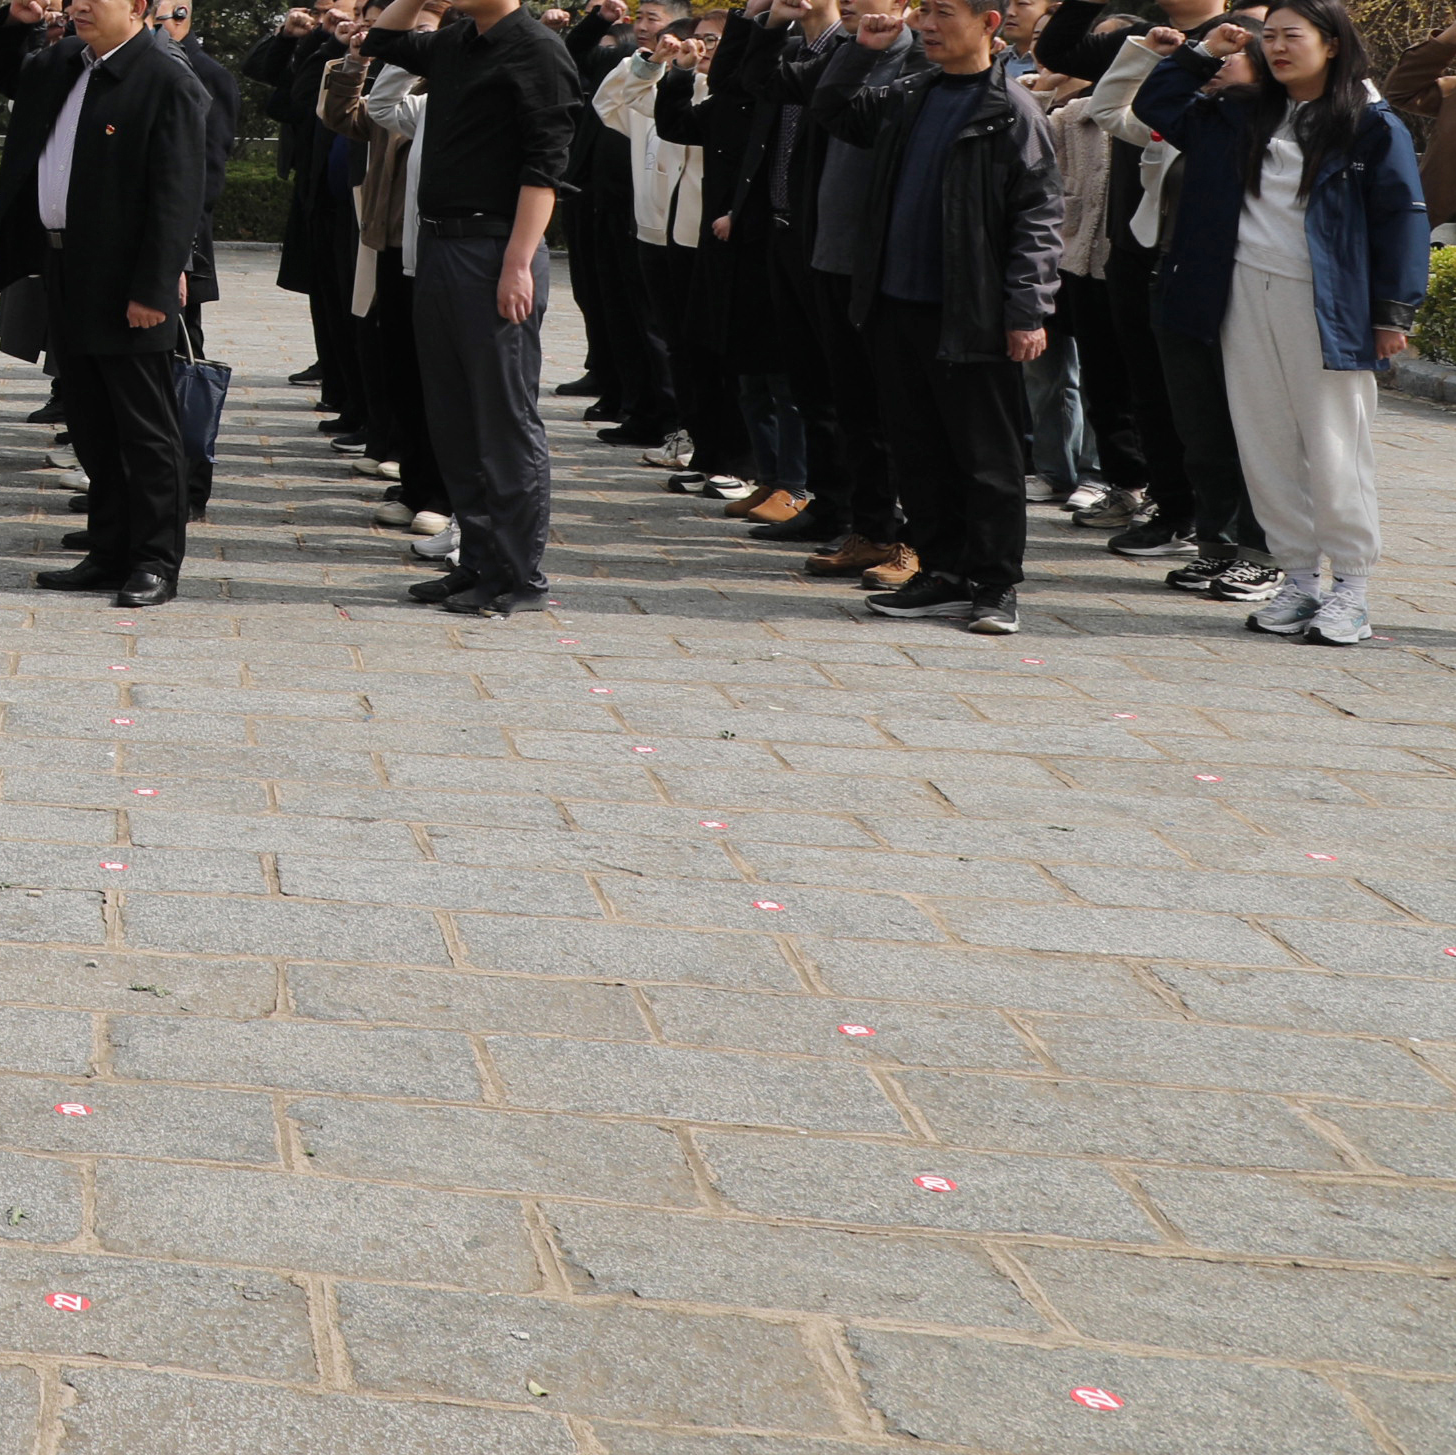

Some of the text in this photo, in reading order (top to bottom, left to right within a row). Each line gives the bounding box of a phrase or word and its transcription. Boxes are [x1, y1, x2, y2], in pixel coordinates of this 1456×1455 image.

[844, 1026, 869, 1036] 18
[61, 1103, 87, 1115] 20
[920, 1177, 951, 1191] 20
[53, 1293, 82, 1311] 22
[1076, 1388, 1120, 1408] 22
